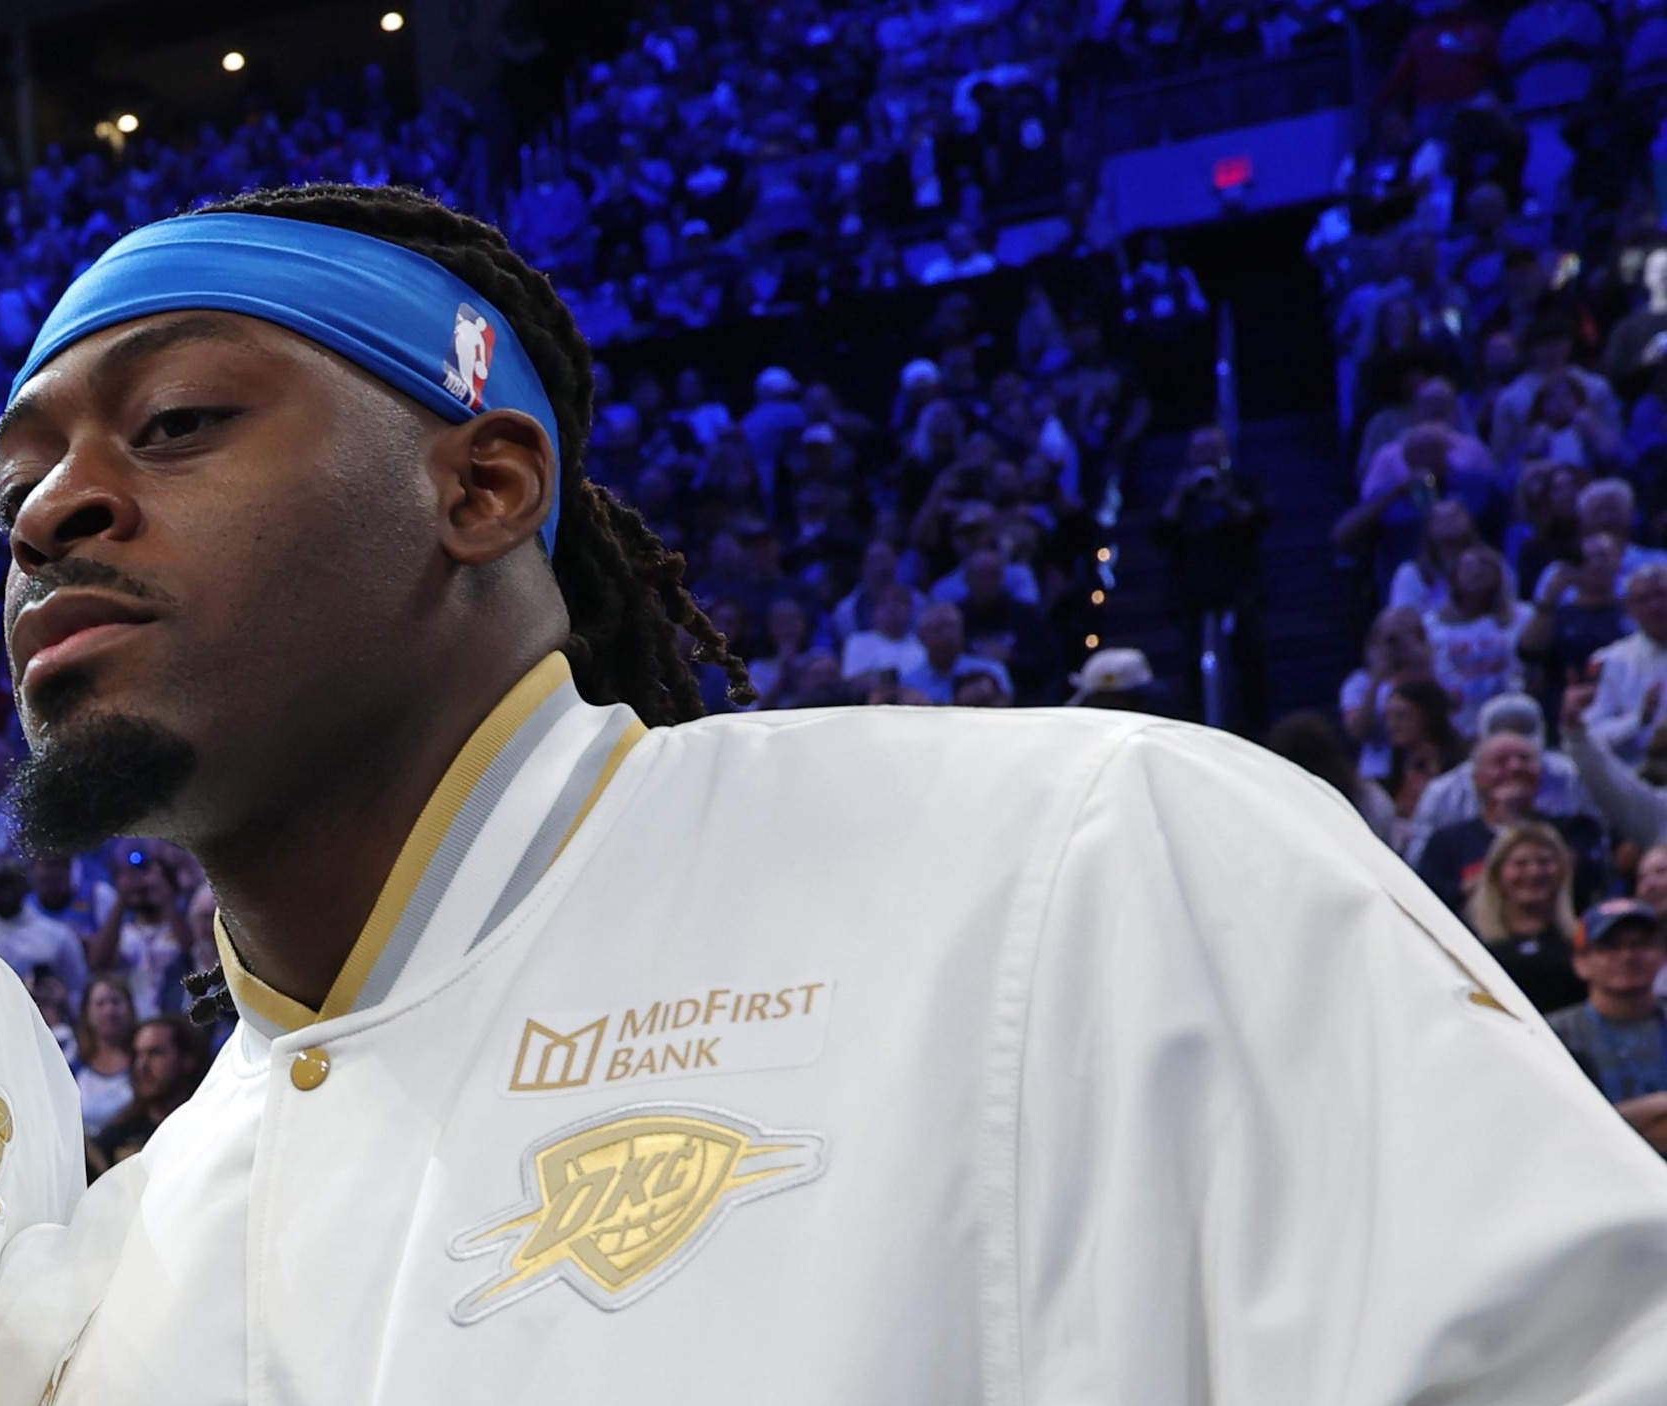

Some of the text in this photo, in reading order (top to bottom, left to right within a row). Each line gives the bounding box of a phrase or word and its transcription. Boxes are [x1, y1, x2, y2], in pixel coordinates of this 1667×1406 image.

[443, 371, 468, 401] NBA
[605, 1036, 722, 1083] BANK
[521, 1143, 698, 1260] OKC
